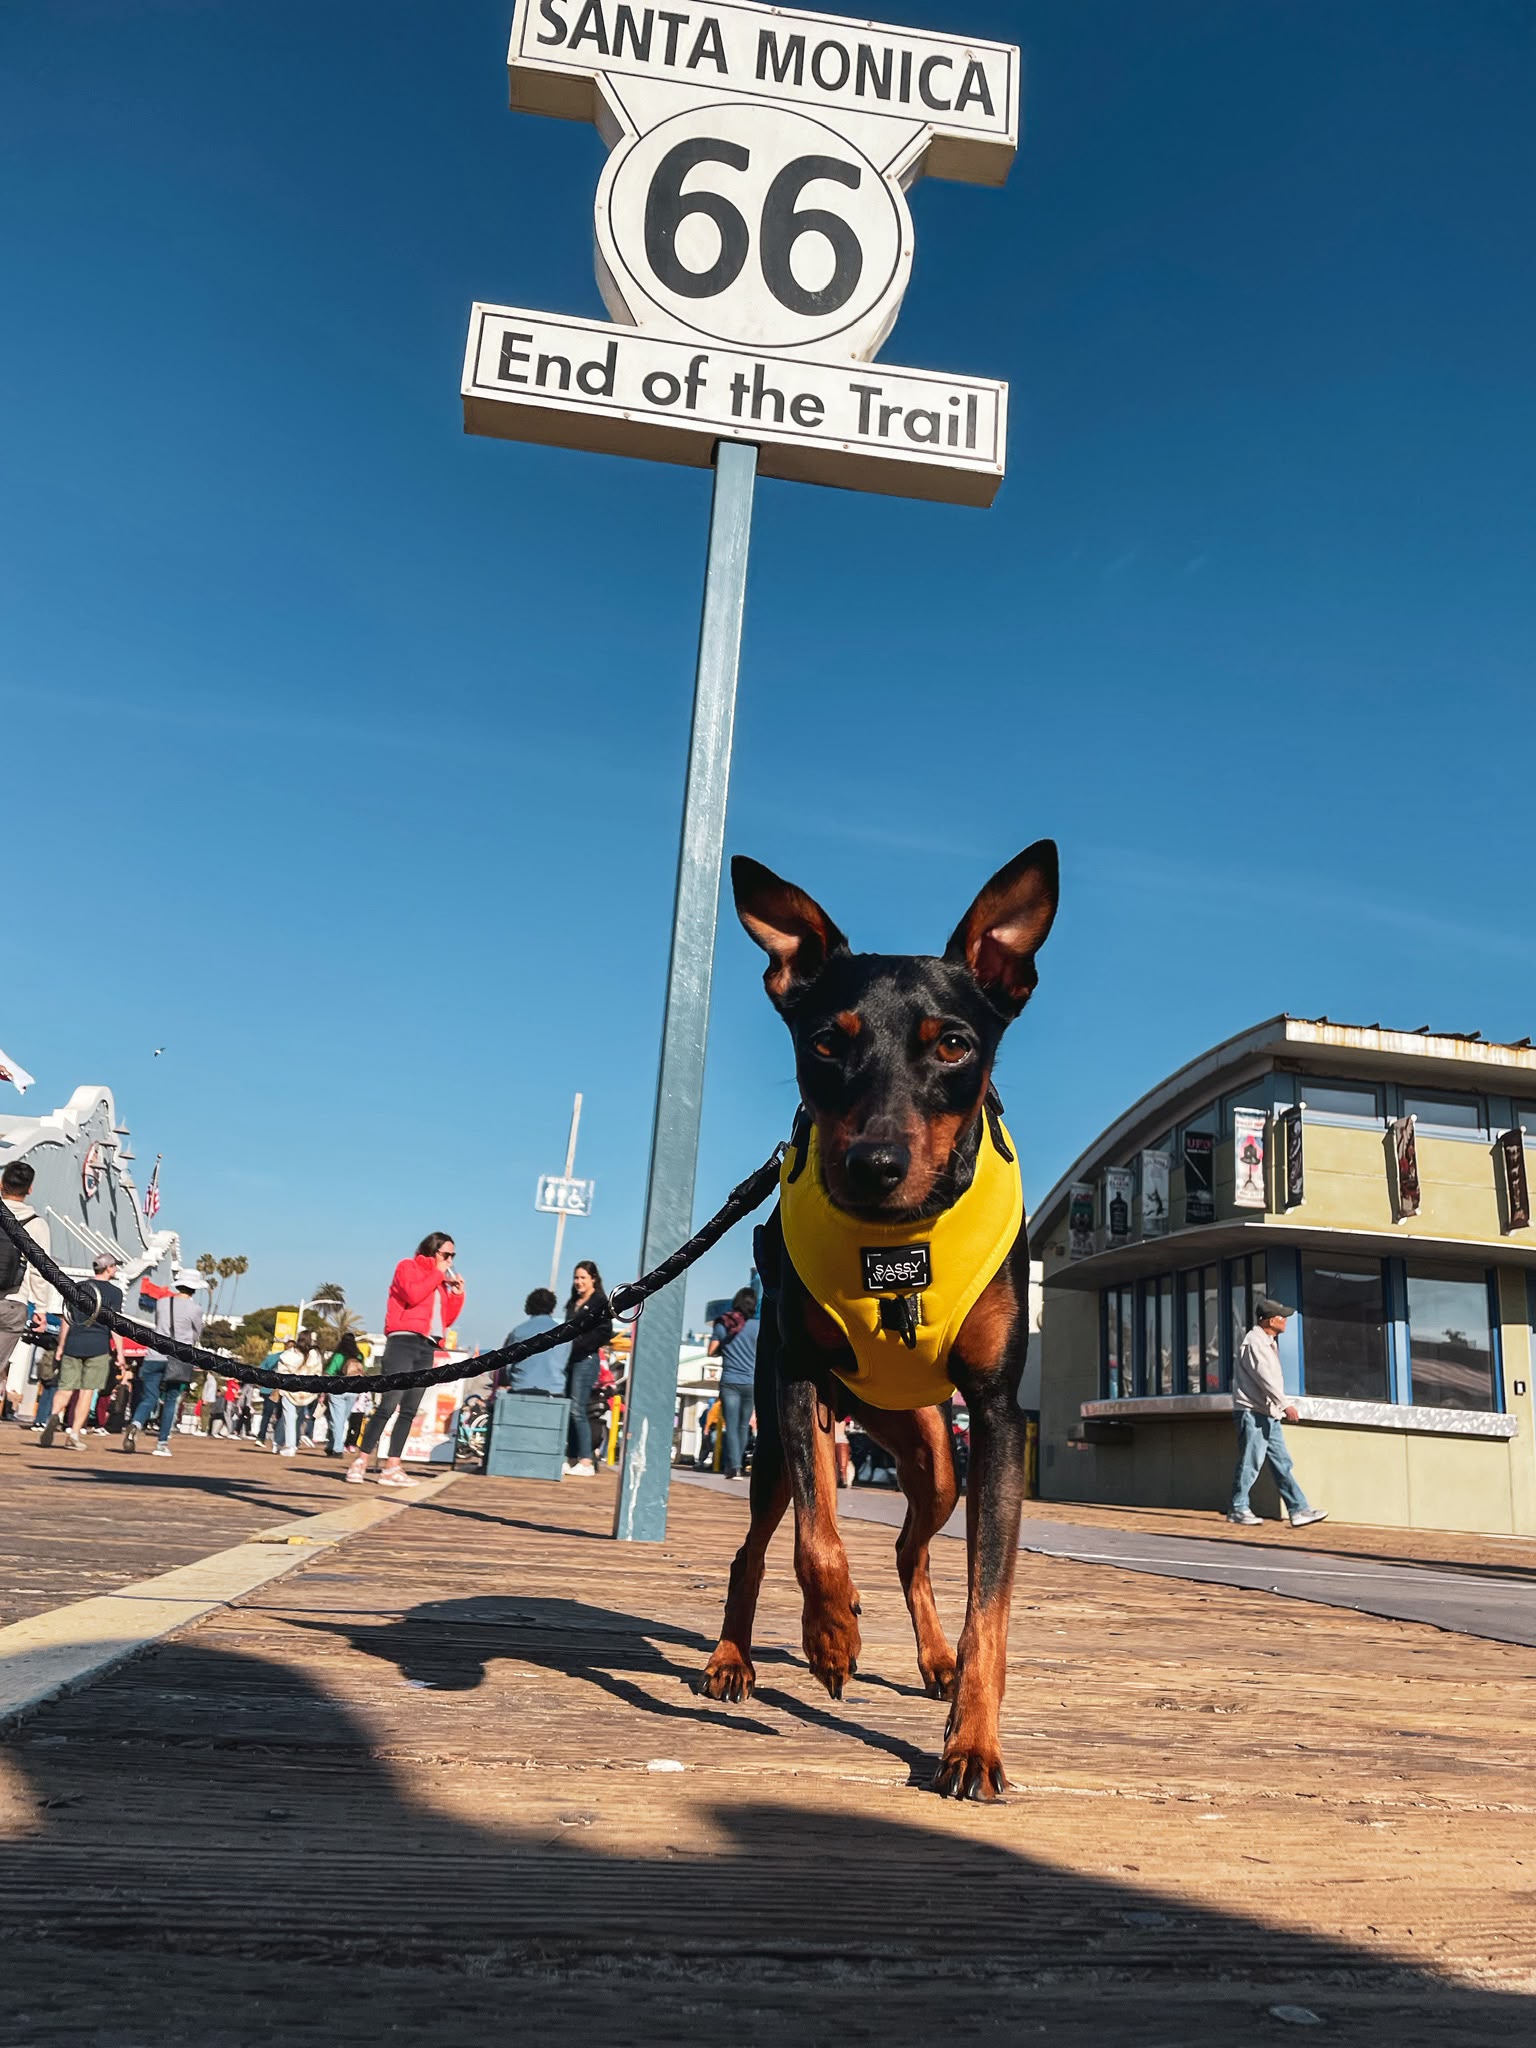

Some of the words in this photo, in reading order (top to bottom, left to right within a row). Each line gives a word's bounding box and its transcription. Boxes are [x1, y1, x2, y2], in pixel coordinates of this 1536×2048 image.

[536, 0, 728, 74] SANTA
[754, 28, 996, 117] MONICA
[643, 136, 864, 317] 66
[496, 331, 619, 397] End
[640, 354, 709, 408] of
[729, 363, 825, 428] the
[848, 383, 979, 450] Trail
[872, 1269, 919, 1282] WOOF
[875, 1261, 921, 1274] SASSY
